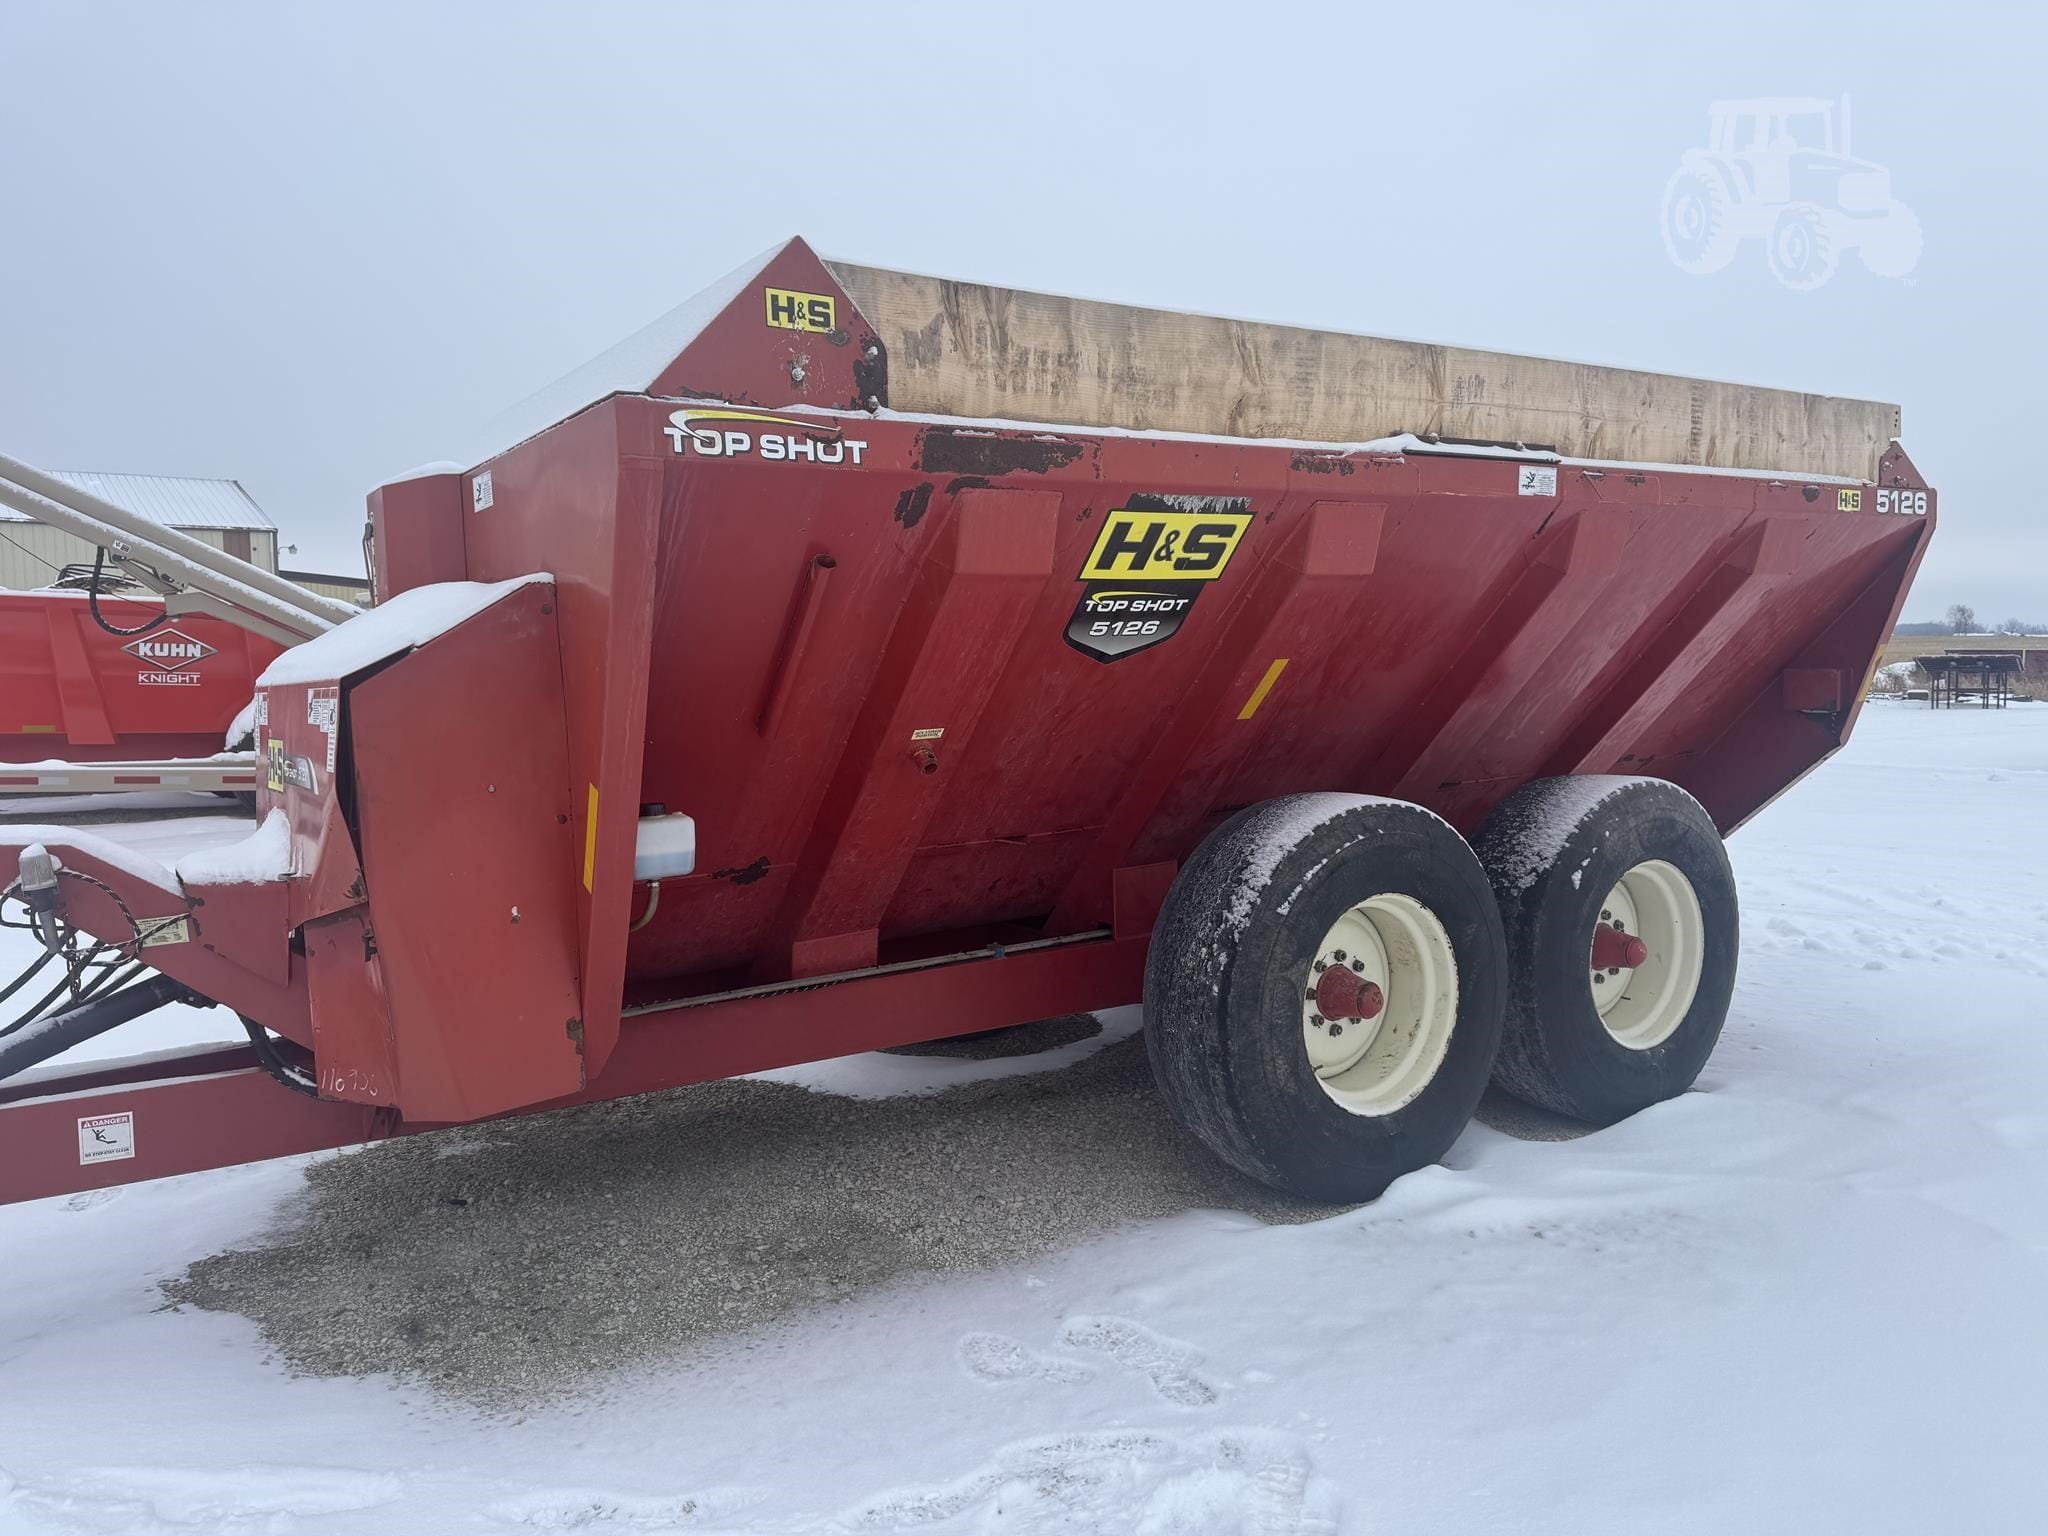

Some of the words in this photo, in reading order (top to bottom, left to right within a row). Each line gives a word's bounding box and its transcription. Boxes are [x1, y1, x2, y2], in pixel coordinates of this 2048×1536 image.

[770, 294, 831, 328] H&S
[664, 427, 751, 456] TOP
[759, 434, 868, 464] SHOT
[1876, 489, 1927, 515] 5126
[1093, 521, 1237, 571] H&S
[1085, 599, 1128, 612] TOP
[1130, 599, 1189, 612] SHOT
[1088, 620, 1160, 636] 5126
[138, 642, 201, 657] KUHN
[138, 673, 201, 683] KNIGHT
[92, 1116, 128, 1127] DANGER
